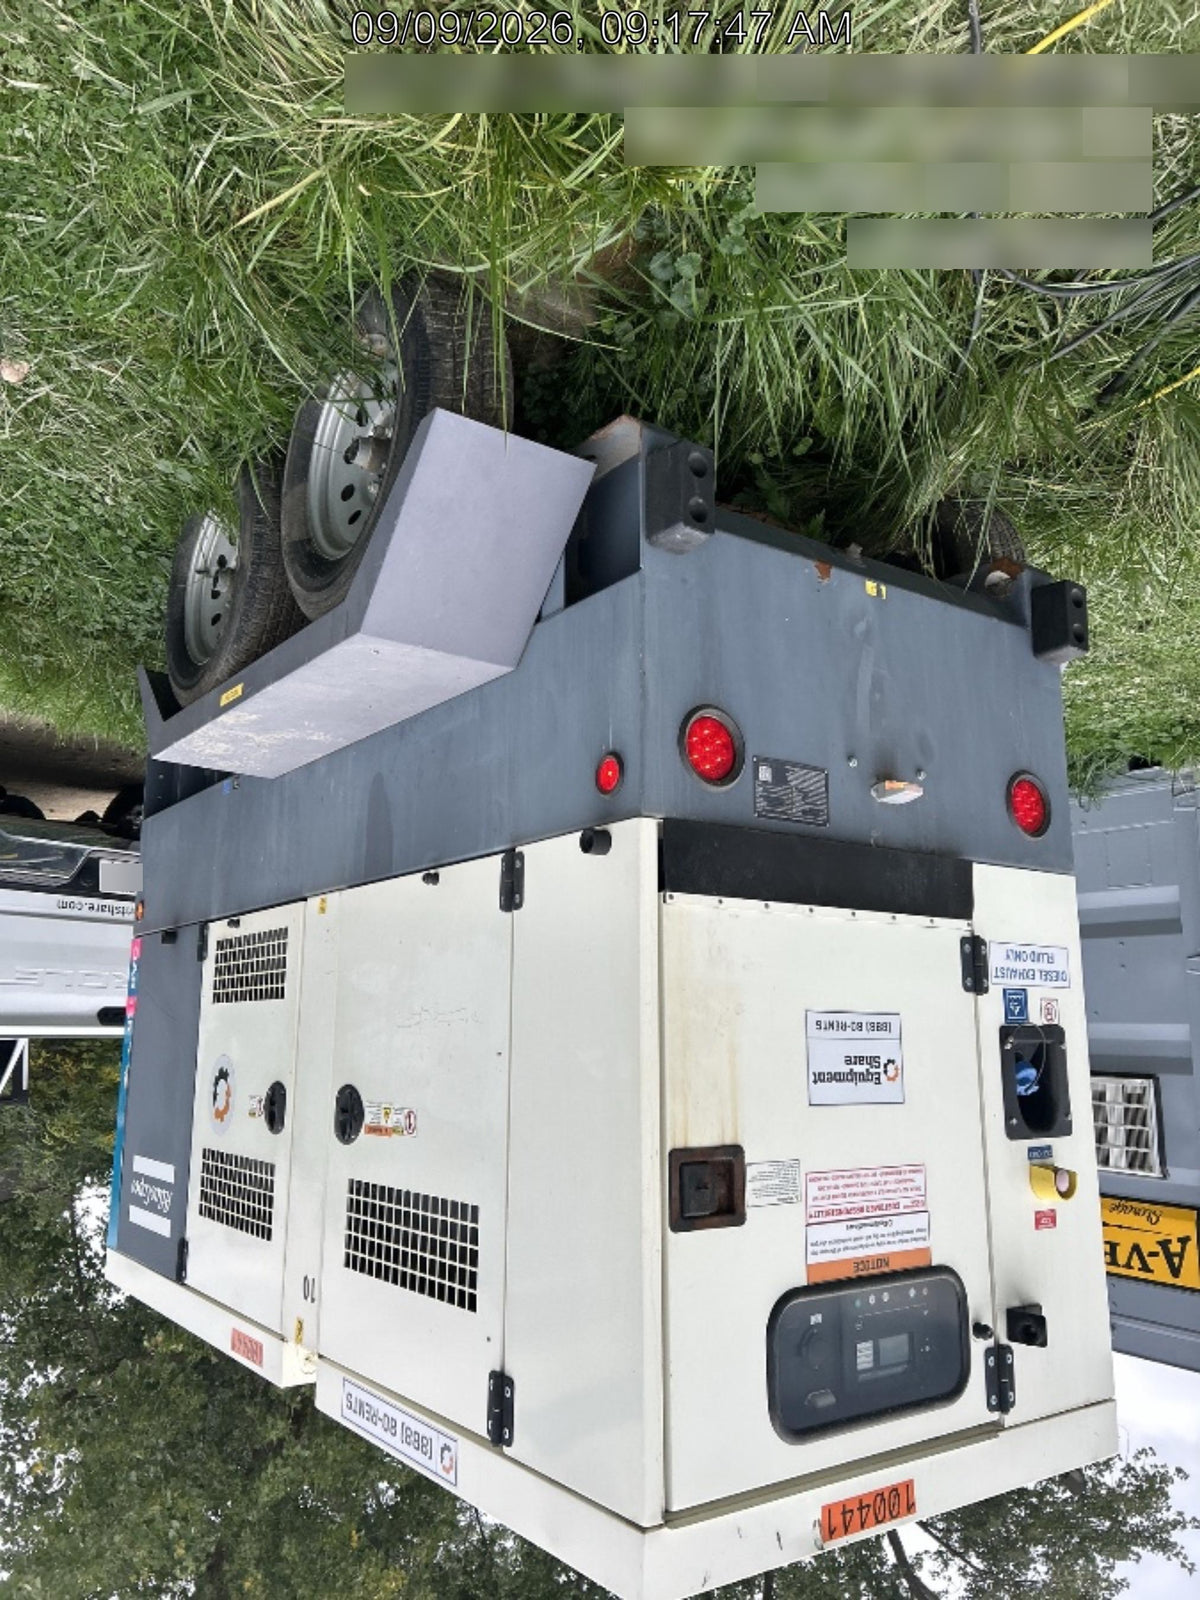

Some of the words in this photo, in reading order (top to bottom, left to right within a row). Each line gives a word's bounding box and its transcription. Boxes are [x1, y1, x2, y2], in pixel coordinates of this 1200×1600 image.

[56, 899, 134, 917] ntshare.com
[1005, 949, 1027, 962] ONLY
[1029, 950, 1055, 964] FLUID
[994, 966, 1036, 980] EXHAUST
[1038, 969, 1068, 983] DIESEL
[844, 1055, 881, 1069] Share
[812, 1069, 882, 1087] Equipment
[1108, 1200, 1162, 1226] Storage
[853, 1257, 890, 1274] NOTICE
[1103, 1235, 1191, 1279] A-VE
[826, 1483, 916, 1540] 100441
